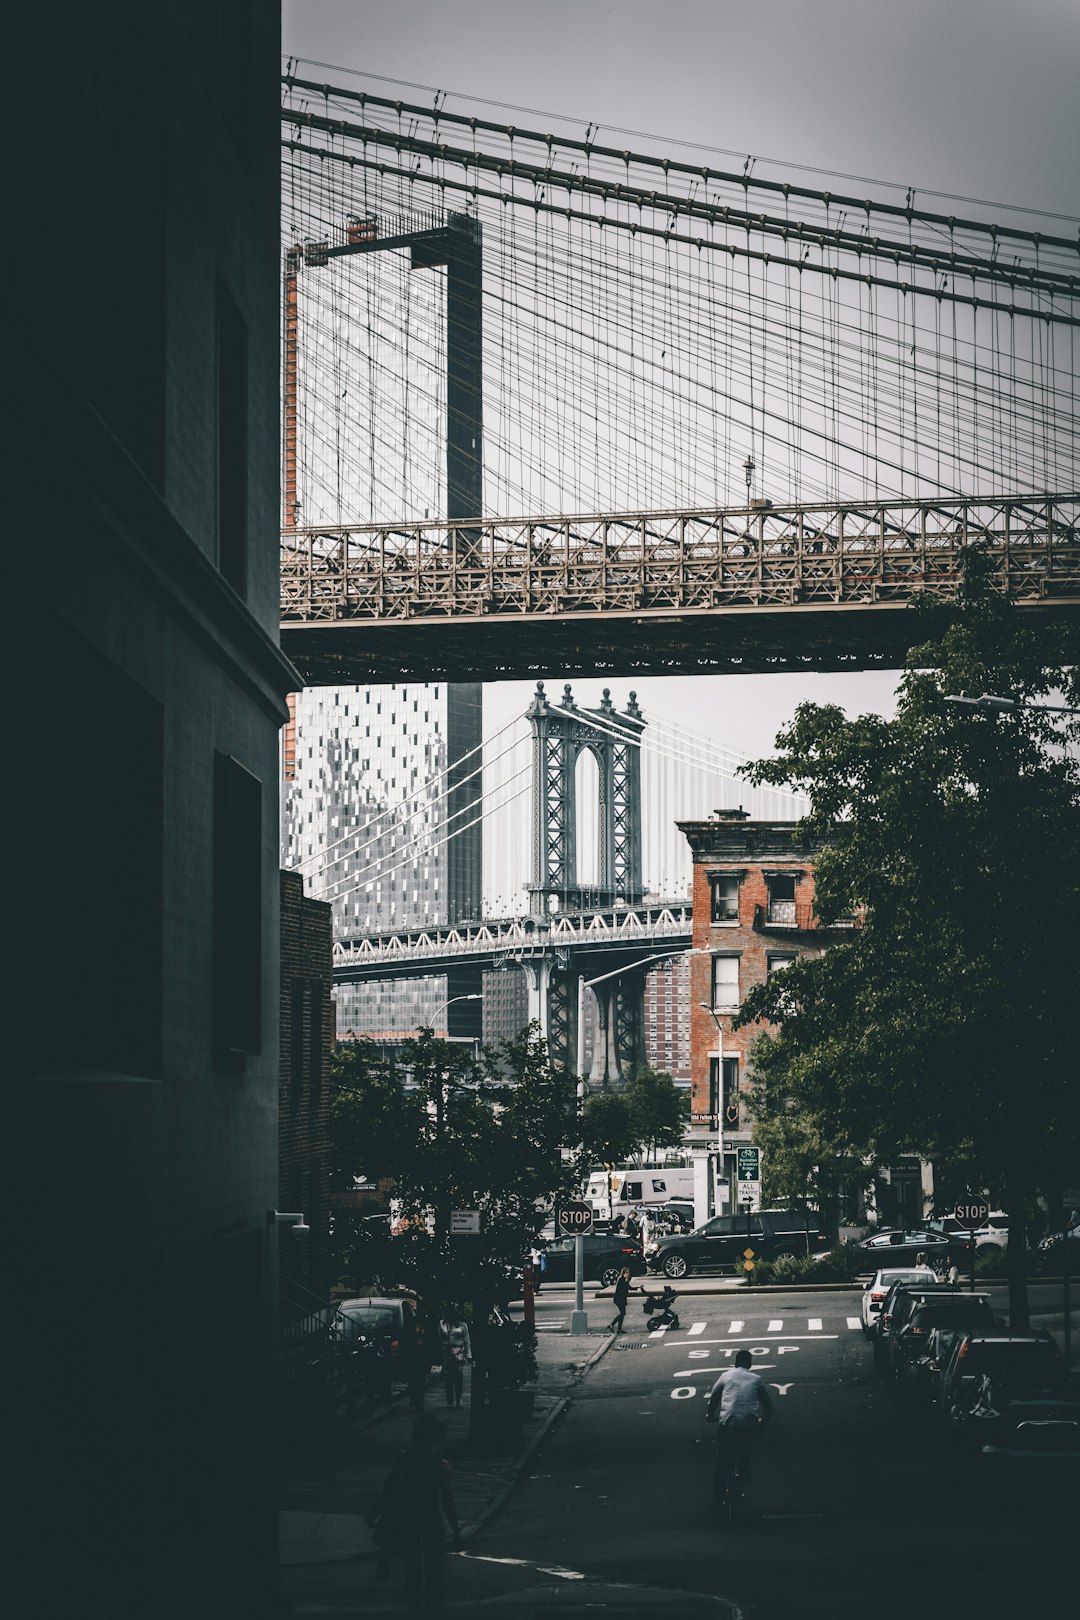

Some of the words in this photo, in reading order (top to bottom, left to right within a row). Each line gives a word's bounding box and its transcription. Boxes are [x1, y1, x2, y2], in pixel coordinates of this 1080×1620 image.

[561, 1211, 591, 1224] STOP
[956, 1205, 987, 1219] STOP
[687, 1346, 800, 1359] STOP
[670, 1382, 795, 1400] OY
